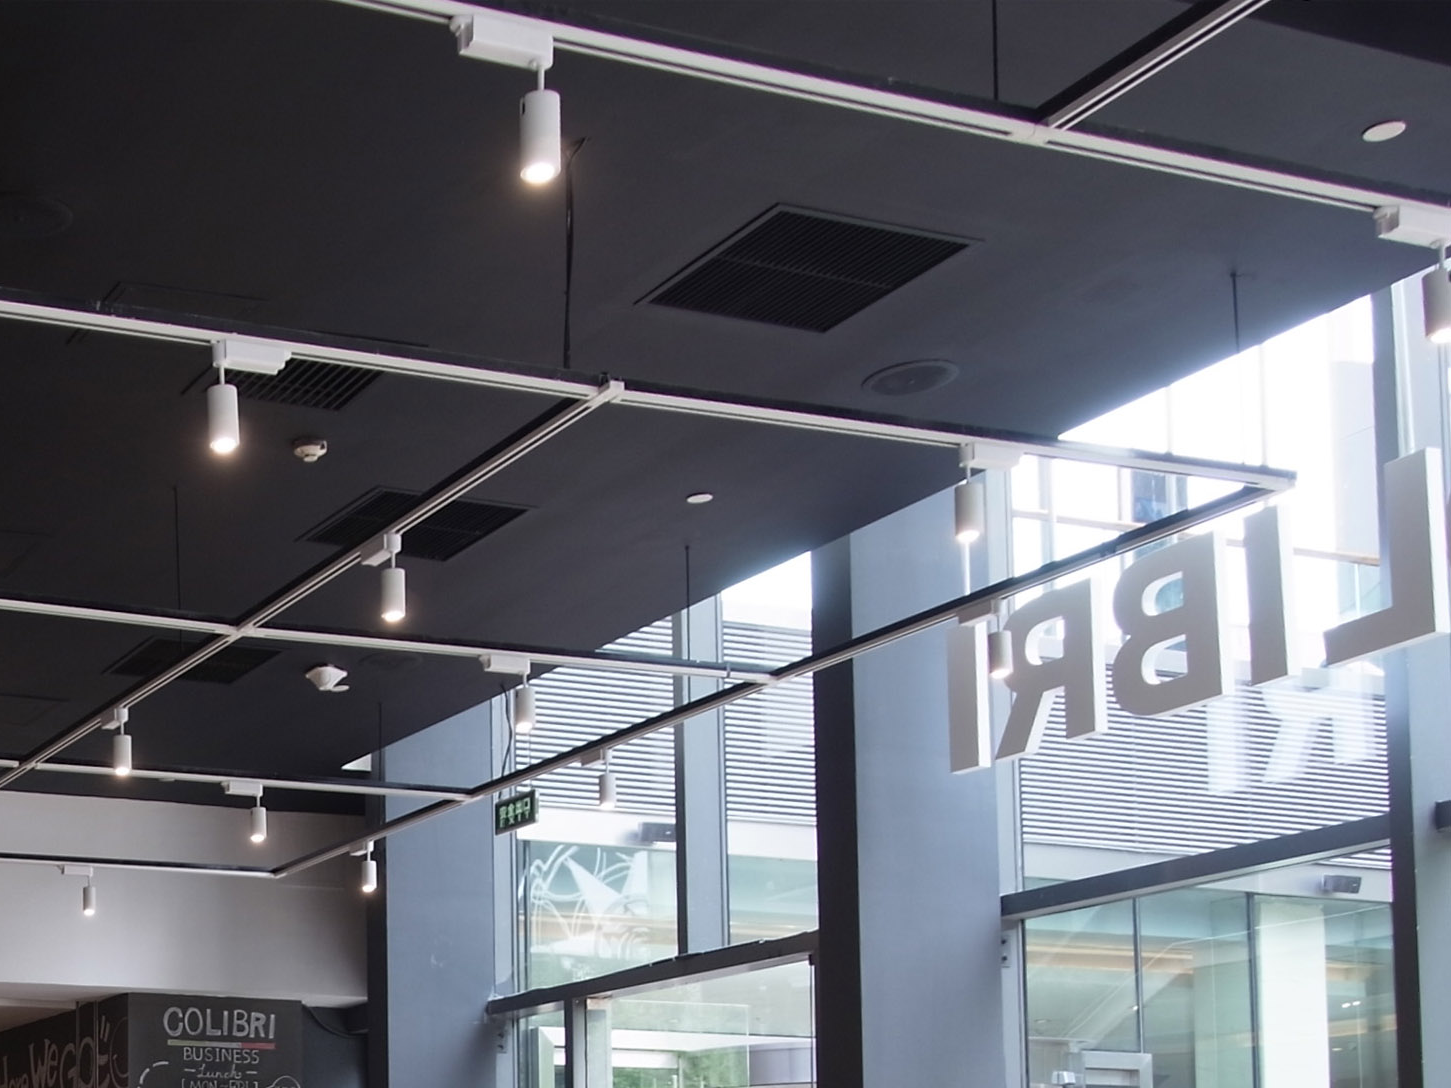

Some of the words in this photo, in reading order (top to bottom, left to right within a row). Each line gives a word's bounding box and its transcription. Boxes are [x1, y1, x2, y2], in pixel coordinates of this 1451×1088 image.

[163, 1006, 276, 1039] COLIBRI
[183, 1047, 260, 1064] BUSINESS
[197, 1063, 242, 1079] Lunch
